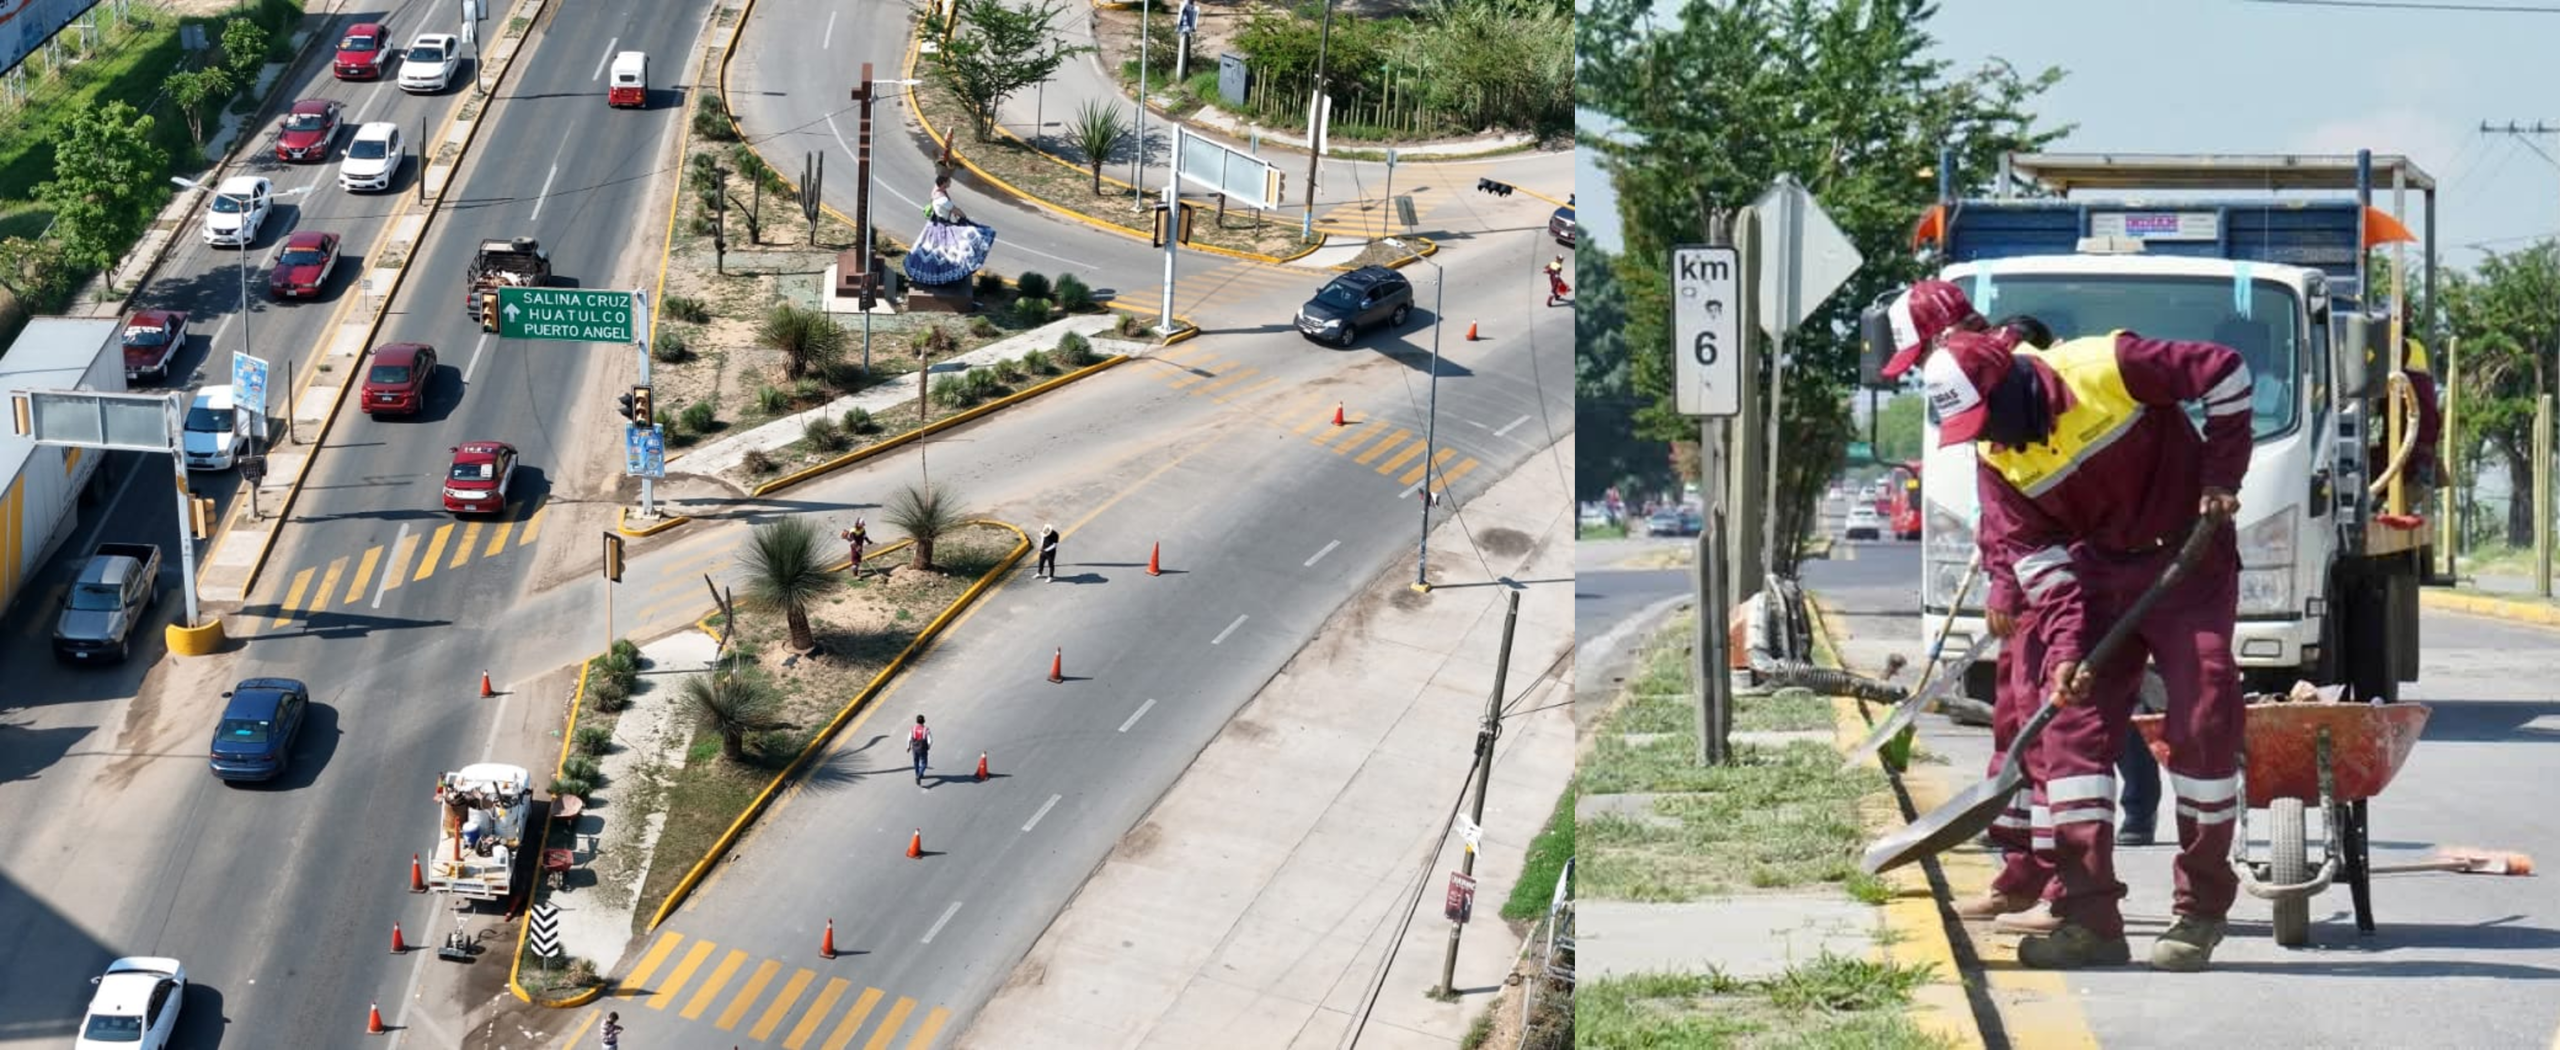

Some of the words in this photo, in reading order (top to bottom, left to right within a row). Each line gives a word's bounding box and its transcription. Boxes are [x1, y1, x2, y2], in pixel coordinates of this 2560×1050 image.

[1680, 253, 1728, 281] km
[523, 292, 581, 306] SALINA
[586, 294, 629, 308] CRUZ
[529, 308, 626, 323] HUATULCO
[524, 323, 579, 337] PUERTO
[582, 326, 630, 340] ANGEL
[1694, 331, 1718, 366] 6
